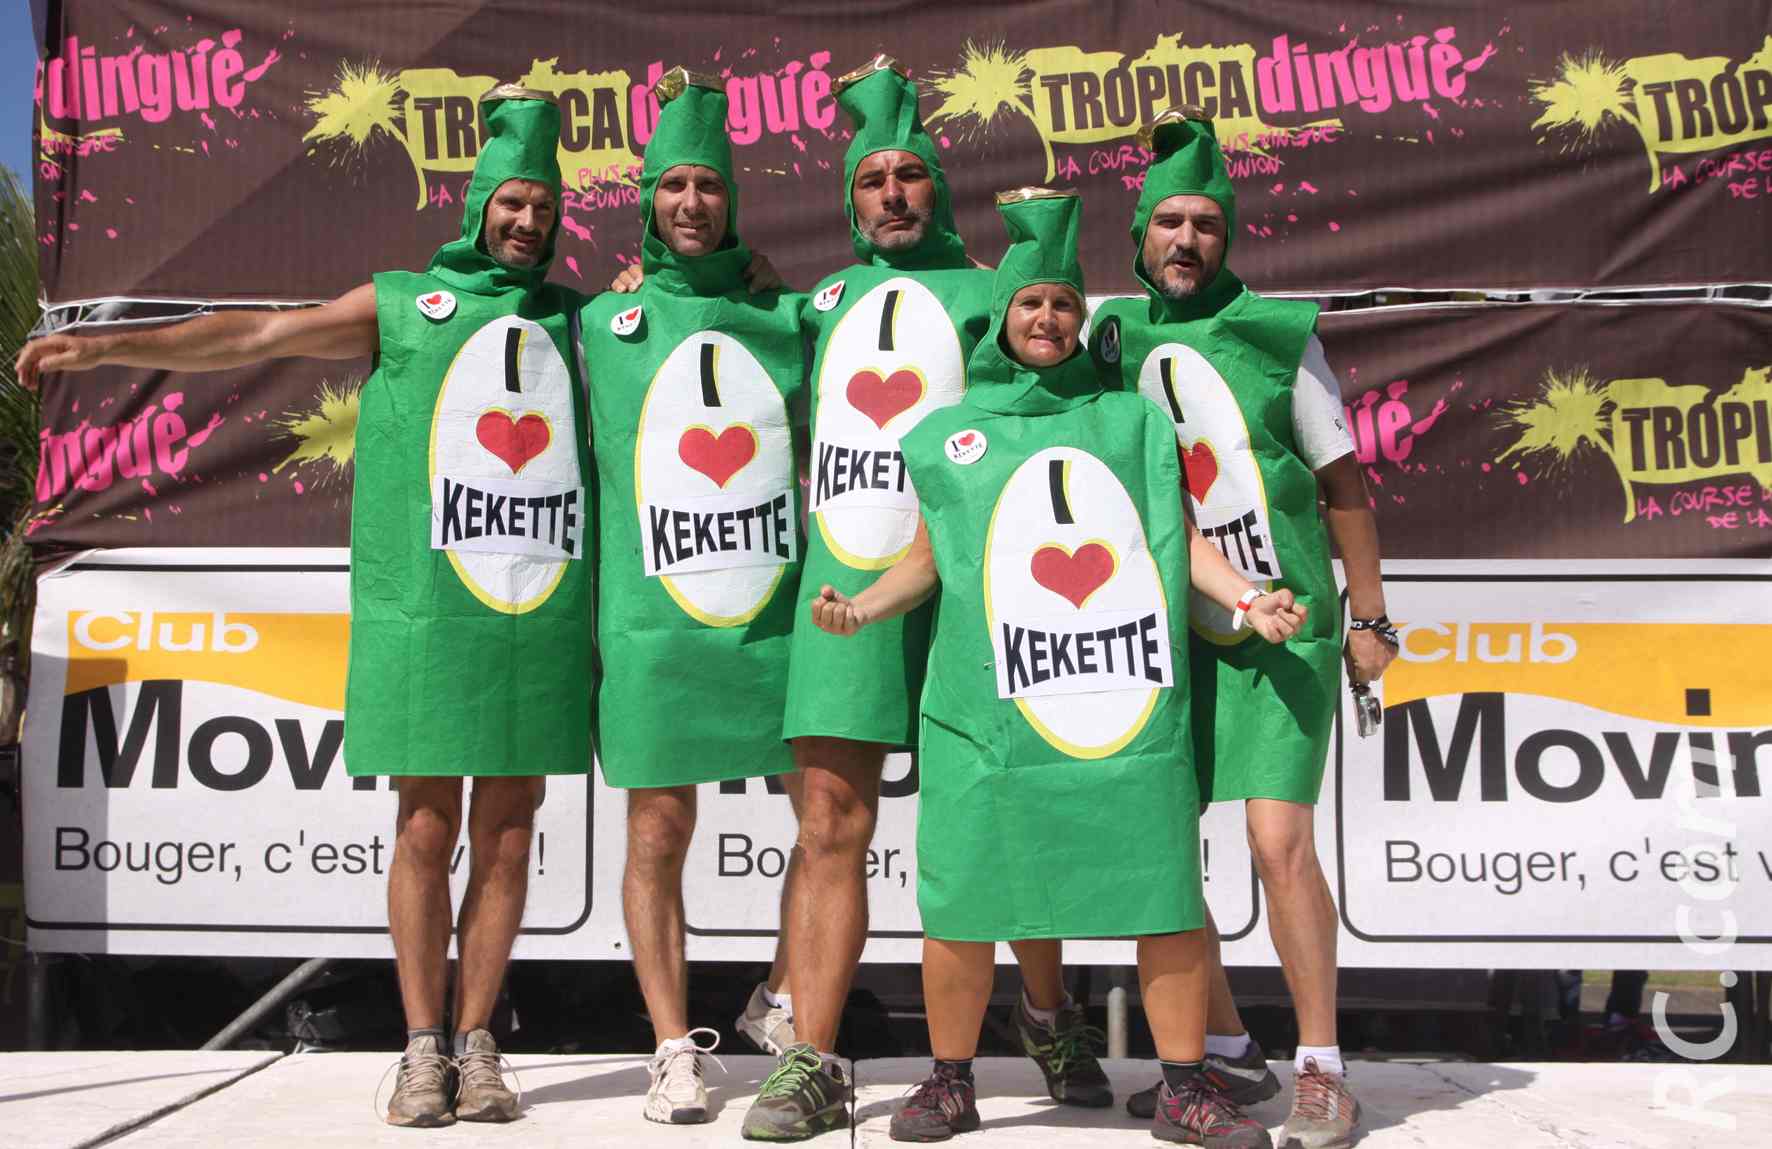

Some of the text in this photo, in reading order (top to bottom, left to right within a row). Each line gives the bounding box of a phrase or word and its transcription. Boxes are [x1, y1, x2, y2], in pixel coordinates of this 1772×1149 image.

[414, 87, 624, 160] TRCA
[1057, 155, 1082, 180] LA
[1663, 165, 1688, 192] LA
[878, 290, 899, 351] I
[505, 328, 523, 393] I
[700, 343, 721, 407] I
[1160, 357, 1185, 423] I
[816, 441, 906, 507] KEKET
[1048, 459, 1075, 525] I
[1637, 496, 1663, 520] LA
[1670, 485, 1752, 516] COURSE
[442, 477, 578, 556] KEKETTE
[649, 493, 790, 571] KEKETTE
[1706, 512, 1740, 528] DE
[75, 610, 259, 653] Club
[1003, 613, 1163, 695] KEKETTE
[1399, 621, 1577, 663] Club
[56, 679, 398, 791] Mov
[54, 827, 242, 884] Bouger,
[264, 829, 385, 876] c'est
[718, 833, 907, 888] Boer,
[1385, 840, 1587, 896] Bouger,
